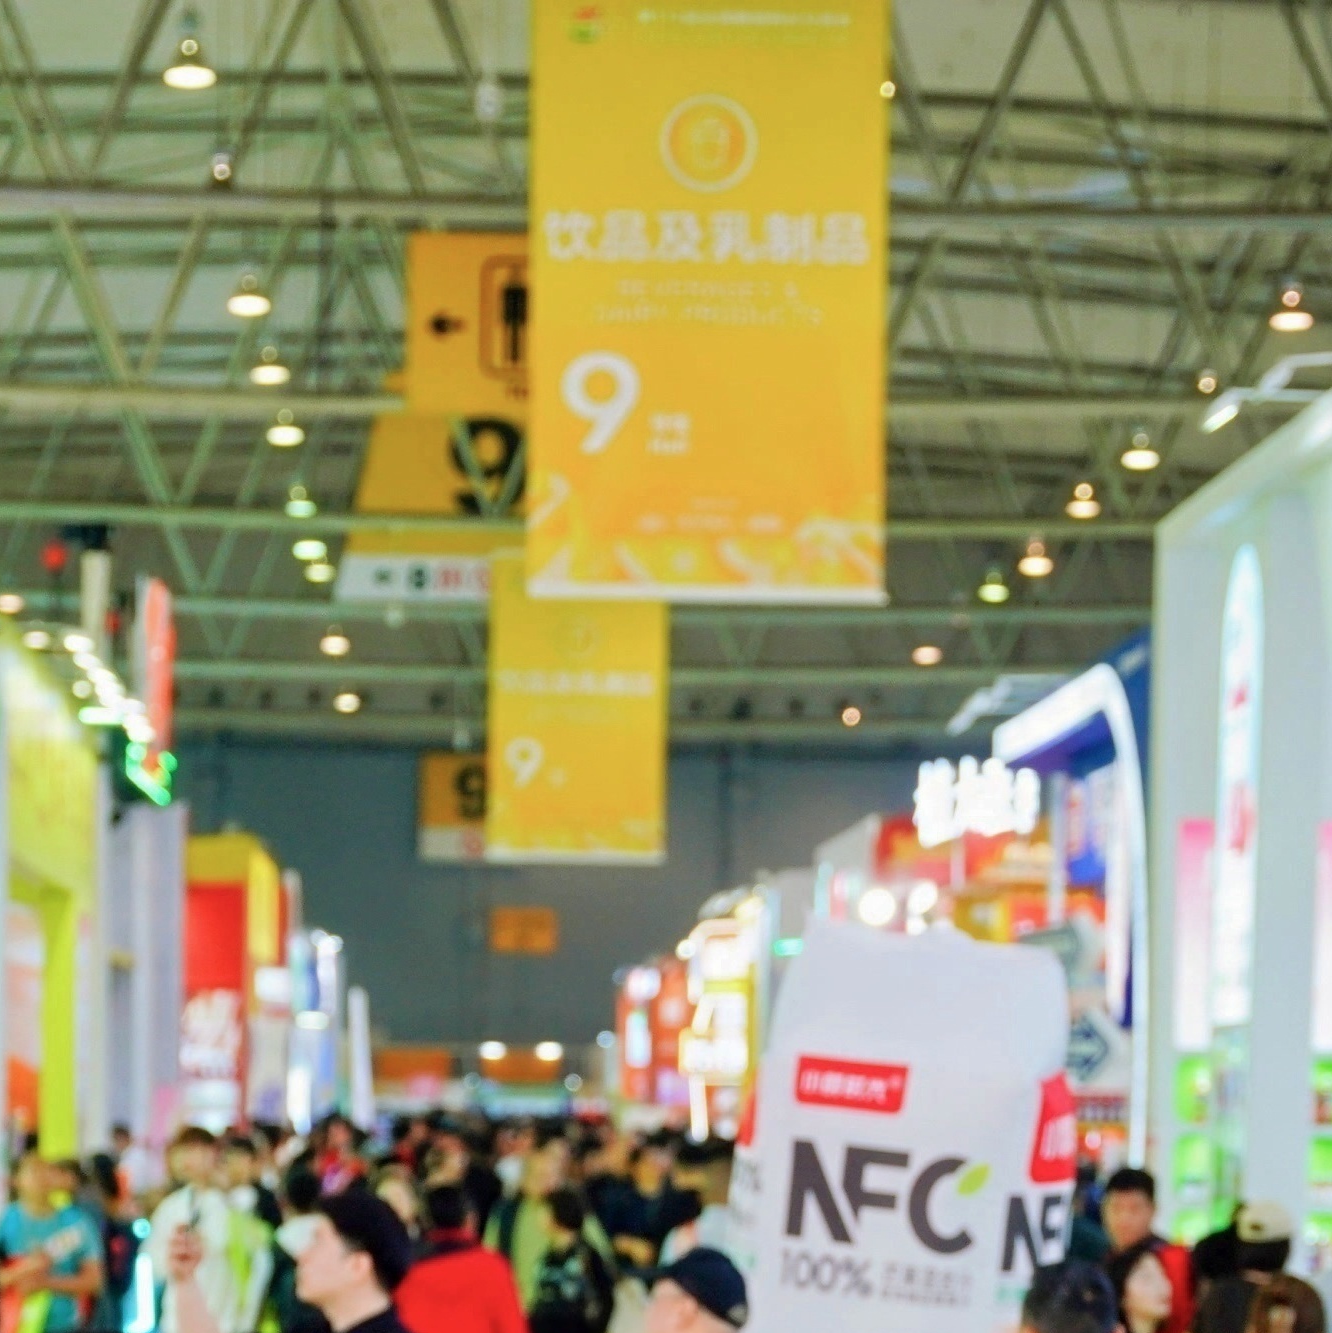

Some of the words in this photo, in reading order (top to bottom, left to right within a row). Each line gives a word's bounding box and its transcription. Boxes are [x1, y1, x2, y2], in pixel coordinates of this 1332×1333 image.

[543, 209, 871, 266] 饮品及乳制品
[560, 350, 641, 455] 9
[505, 737, 546, 788] 9
[785, 1138, 974, 1255] NFC
[780, 1248, 874, 1298] 100%
